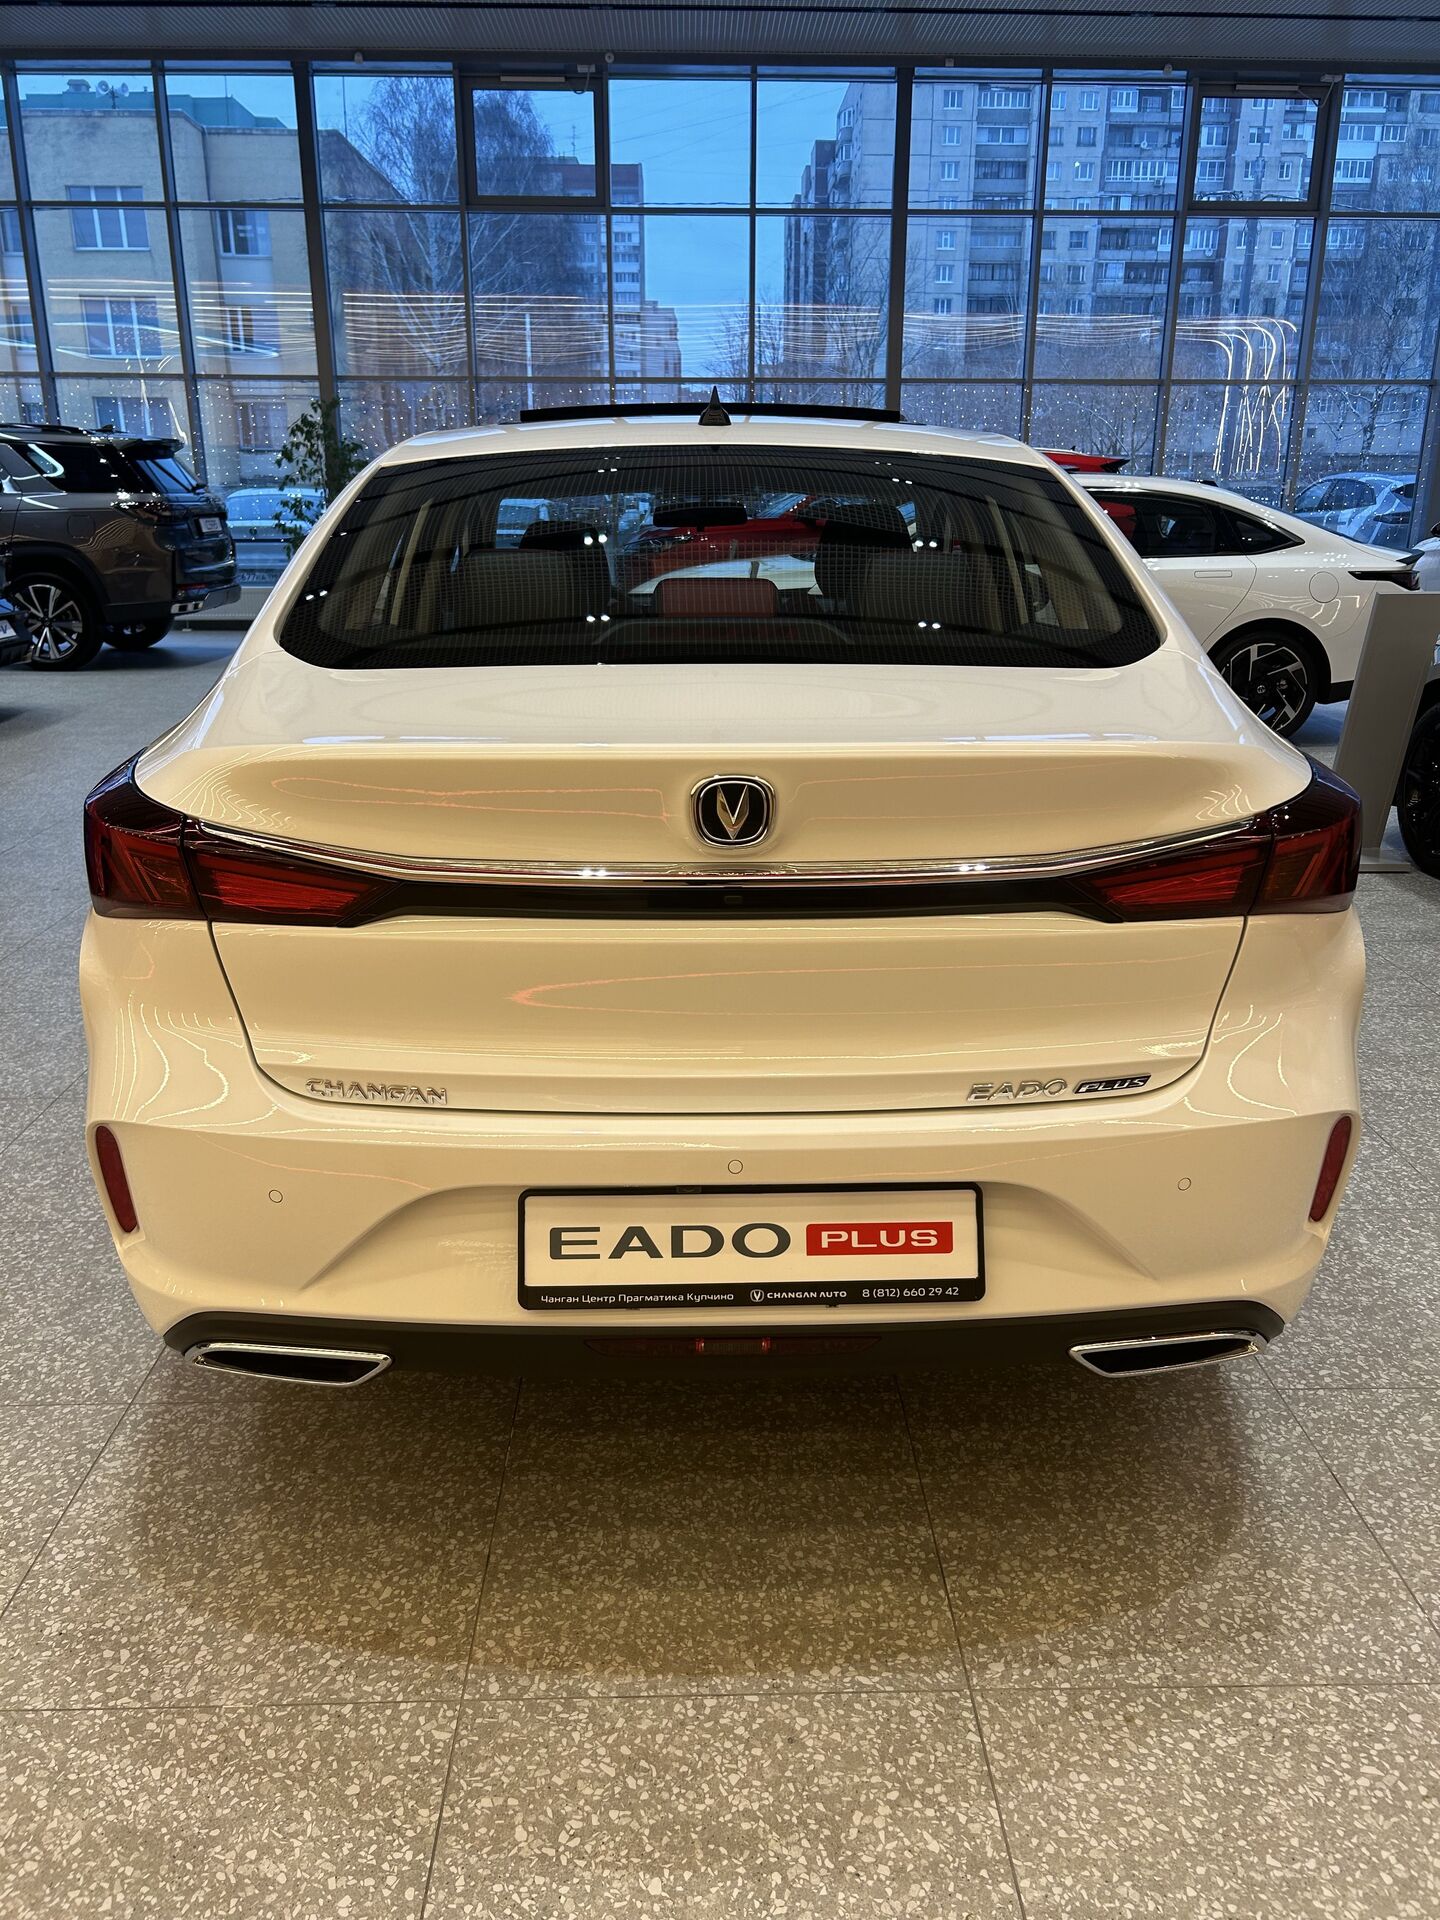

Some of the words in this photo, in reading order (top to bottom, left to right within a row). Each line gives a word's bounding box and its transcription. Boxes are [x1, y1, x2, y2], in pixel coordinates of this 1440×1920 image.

[305, 1077, 448, 1105] CHANGAN
[966, 1078, 1068, 1101] EADO
[1079, 1077, 1147, 1094] PLUS
[549, 1223, 792, 1260] EADO
[821, 1229, 939, 1249] PLUS
[540, 1294, 579, 1304] Чанган
[581, 1294, 616, 1304] Центр
[618, 1293, 684, 1304] Прагматика
[686, 1292, 734, 1303] Купчино
[766, 1291, 817, 1300] CHANGAN
[819, 1290, 848, 1299] AUTO
[862, 1288, 871, 1298] 8
[872, 1288, 900, 1299] (812)
[902, 1287, 926, 1298] 660
[928, 1286, 943, 1297] 29
[945, 1286, 960, 1297] 42
